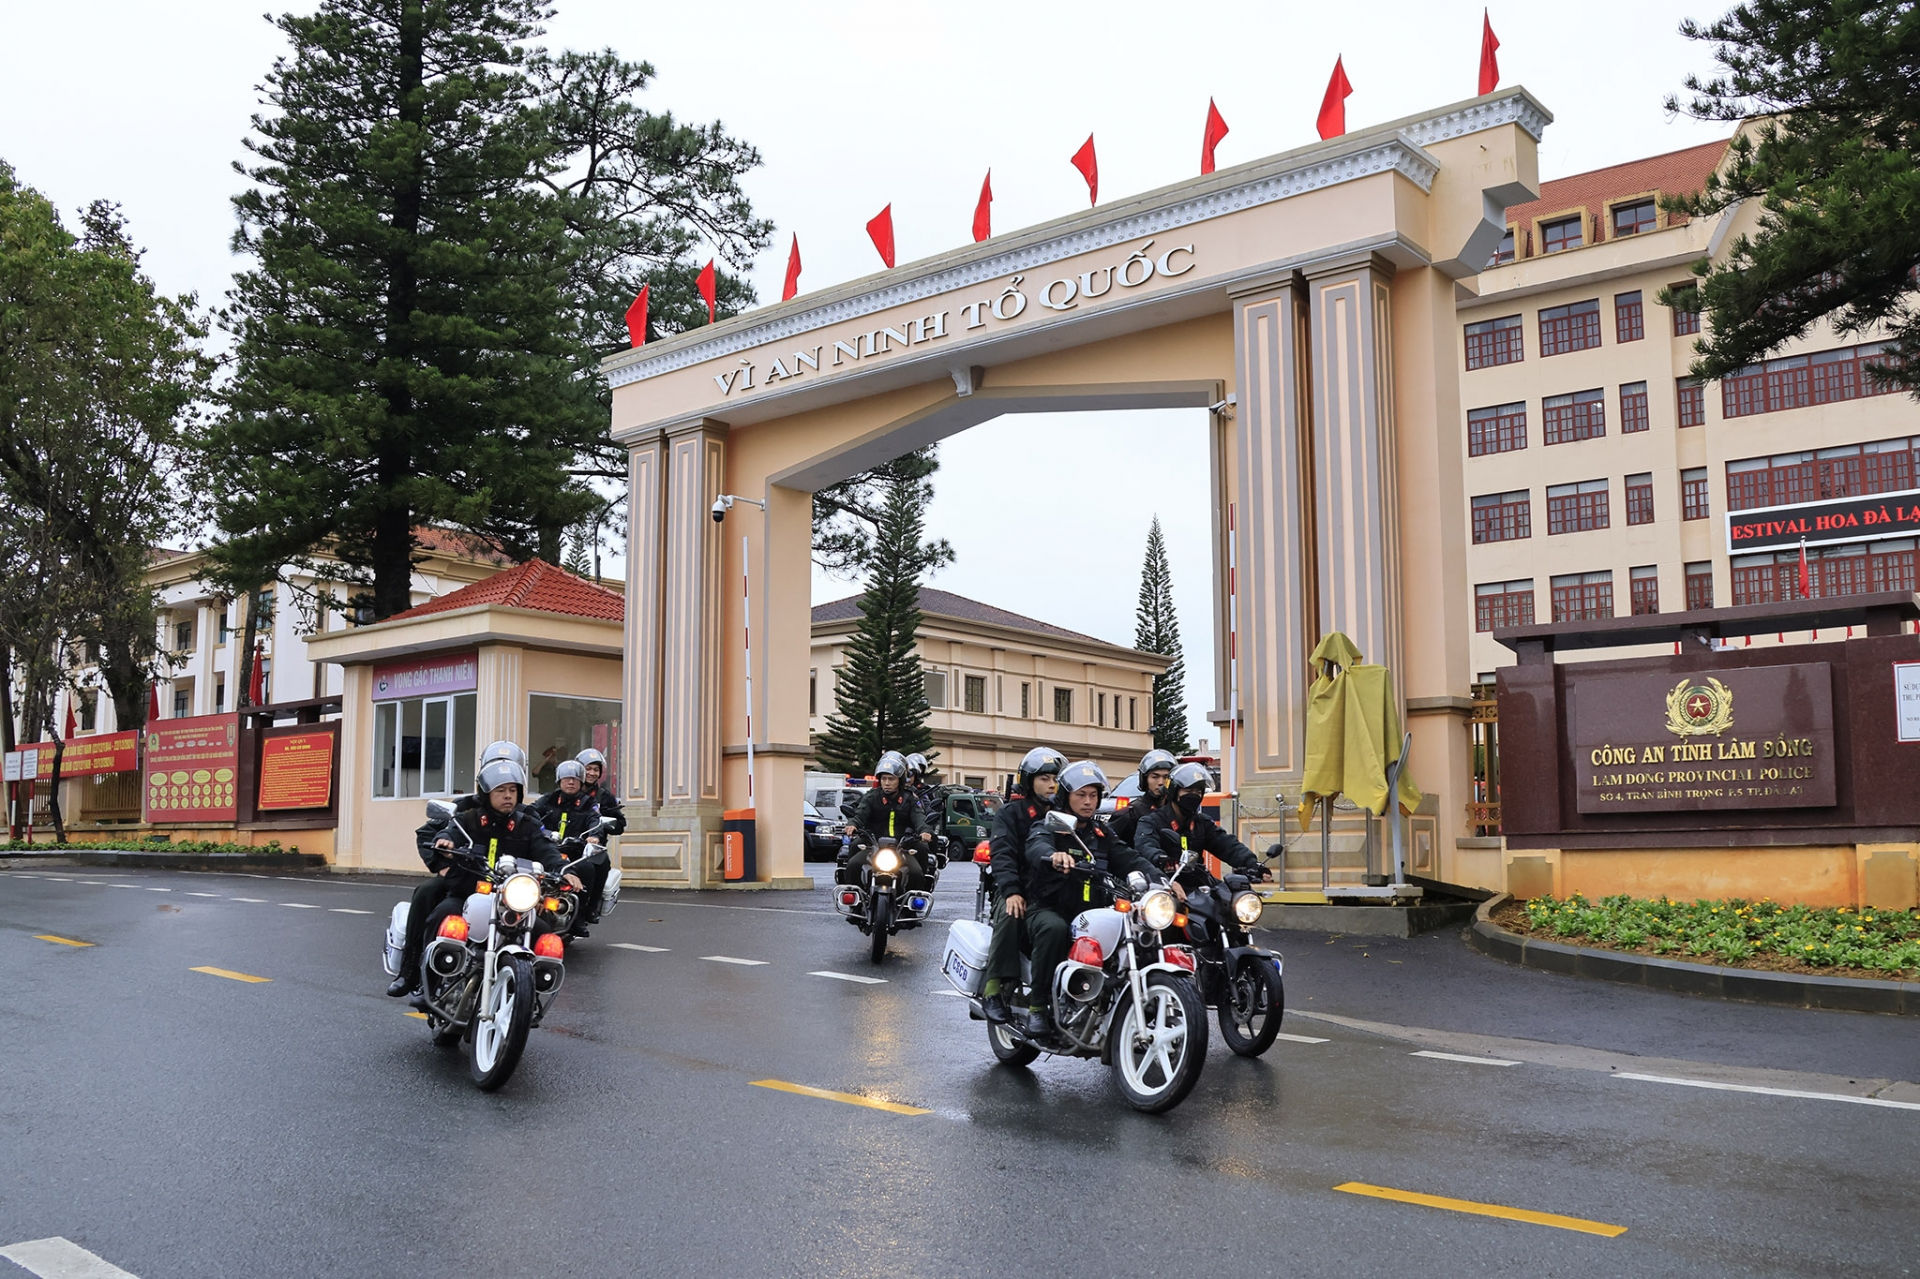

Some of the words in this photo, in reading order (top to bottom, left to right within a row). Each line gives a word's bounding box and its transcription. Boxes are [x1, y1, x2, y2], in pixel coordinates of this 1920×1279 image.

[713, 357, 755, 396] VÌ
[765, 345, 823, 385] AN
[832, 310, 949, 367] NINH
[960, 274, 1028, 330] TỔ
[1038, 239, 1196, 311] QUỐC
[1731, 518, 1813, 540] ESTIVAL
[1816, 512, 1859, 531] HOA
[1863, 504, 1892, 525] ĐÀ
[430, 665, 454, 685] THANH
[455, 659, 473, 681] NIÊN
[1591, 744, 1637, 767] CÔNG
[1641, 745, 1666, 764] AN
[1670, 738, 1713, 762] TỈNH
[1717, 737, 1757, 760] LÂM
[1762, 731, 1814, 759] ĐỒNG
[1592, 774, 1622, 787] LAM
[1626, 771, 1665, 785] DONG
[1668, 768, 1756, 783] PROVINCIAL
[1760, 766, 1815, 780] POLICE
[1685, 788, 1724, 800] TRỌNG
